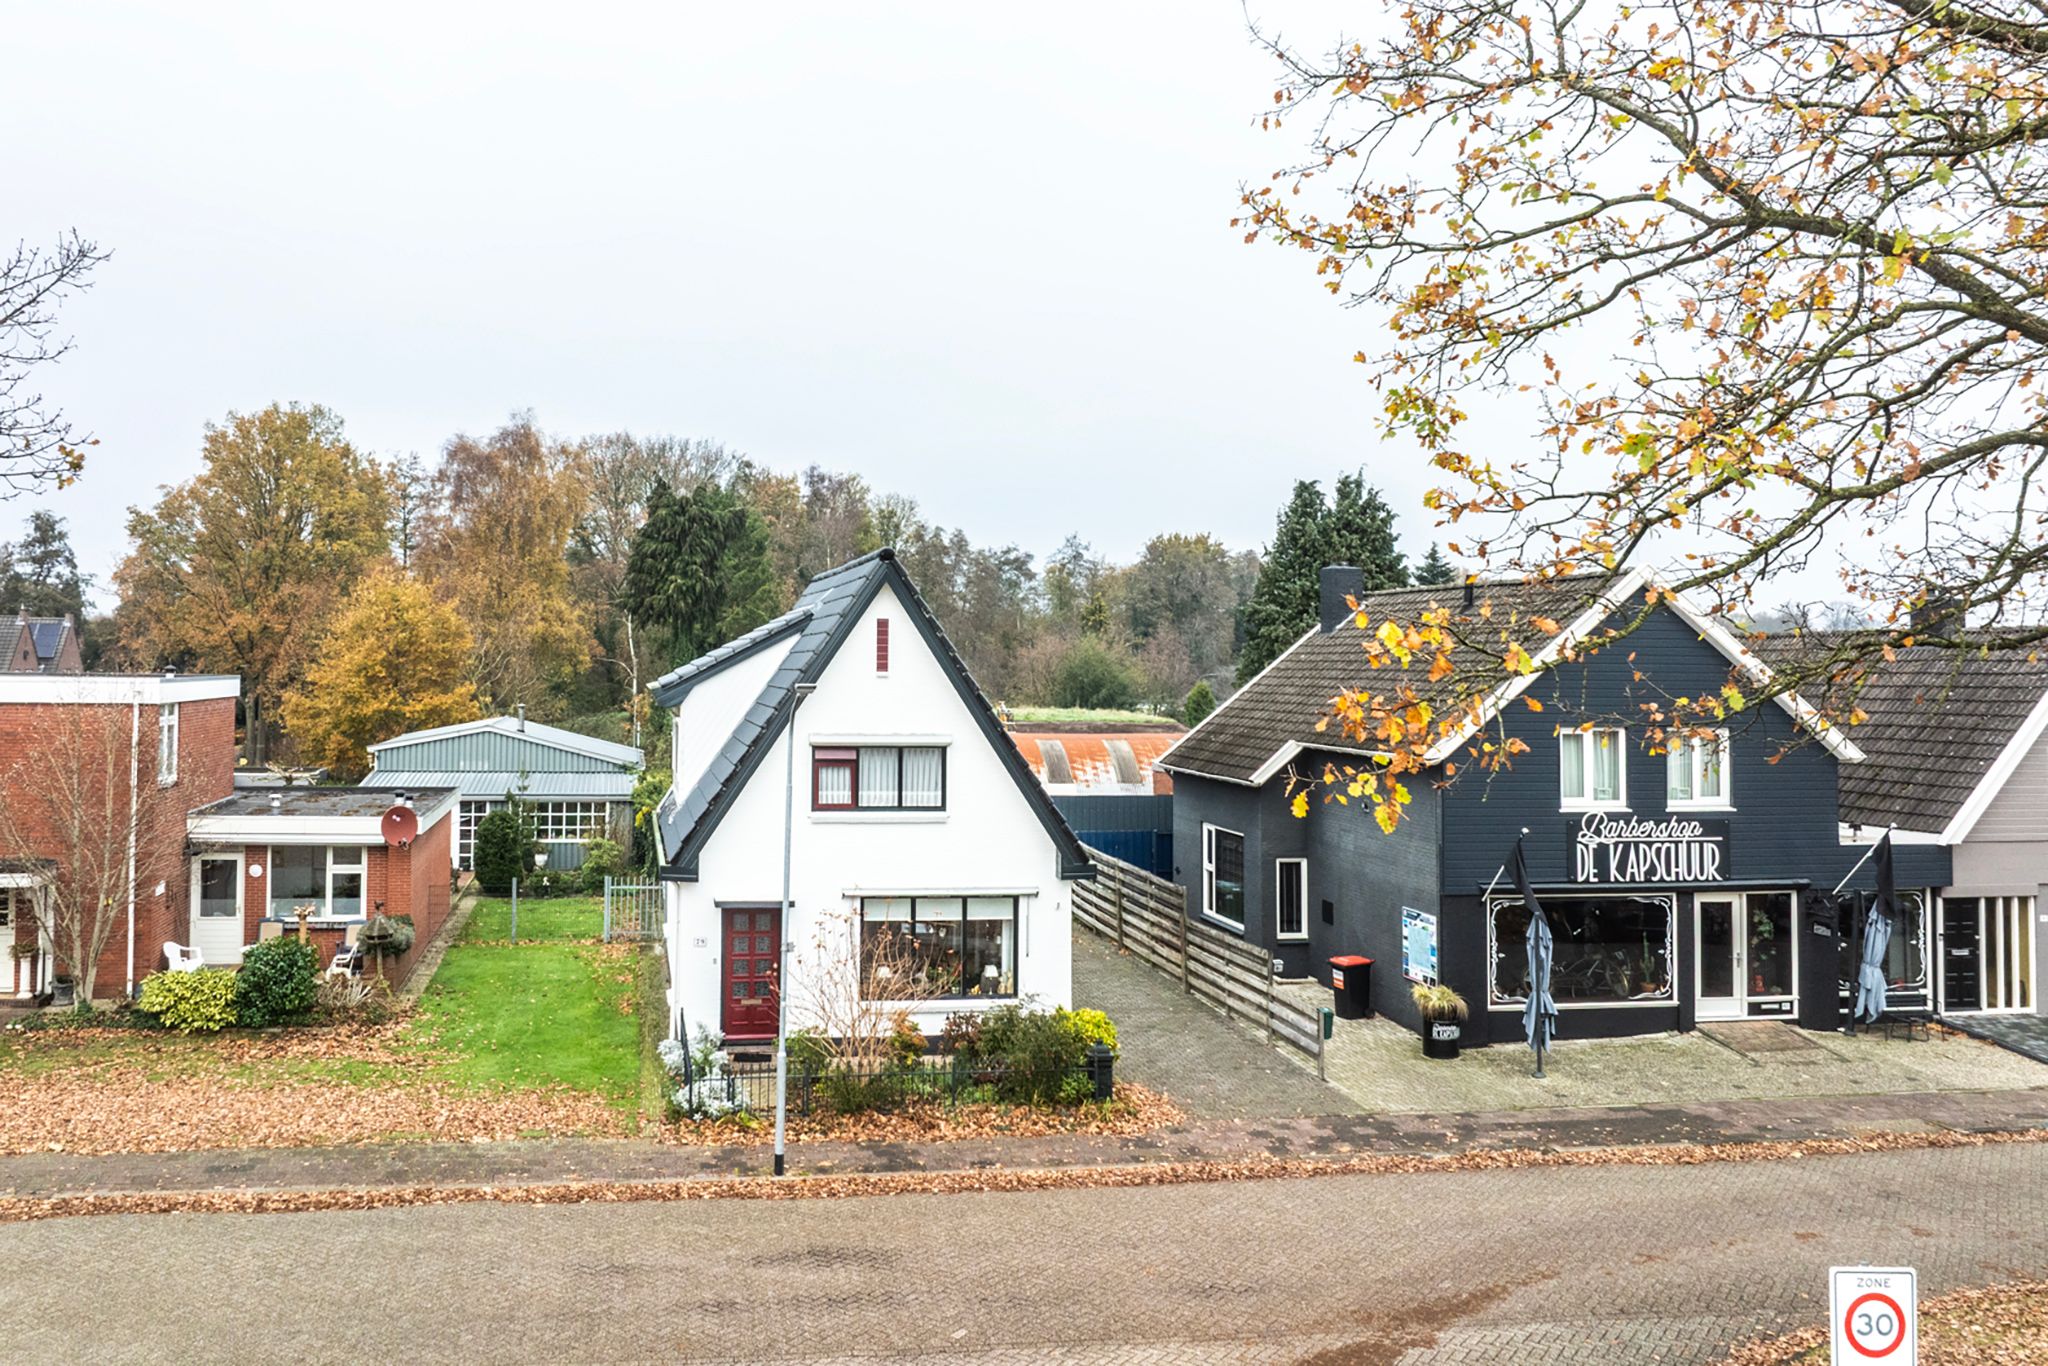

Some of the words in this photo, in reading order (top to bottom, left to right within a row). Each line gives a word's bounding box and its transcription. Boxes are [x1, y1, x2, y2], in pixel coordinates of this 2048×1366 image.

[1578, 811, 1703, 843] Barbershop
[1576, 843, 1600, 883] DE
[1610, 843, 1724, 883] KAPSCHUUR
[1856, 1277, 1892, 1289] ZONE
[1856, 1312, 1894, 1337] 30
